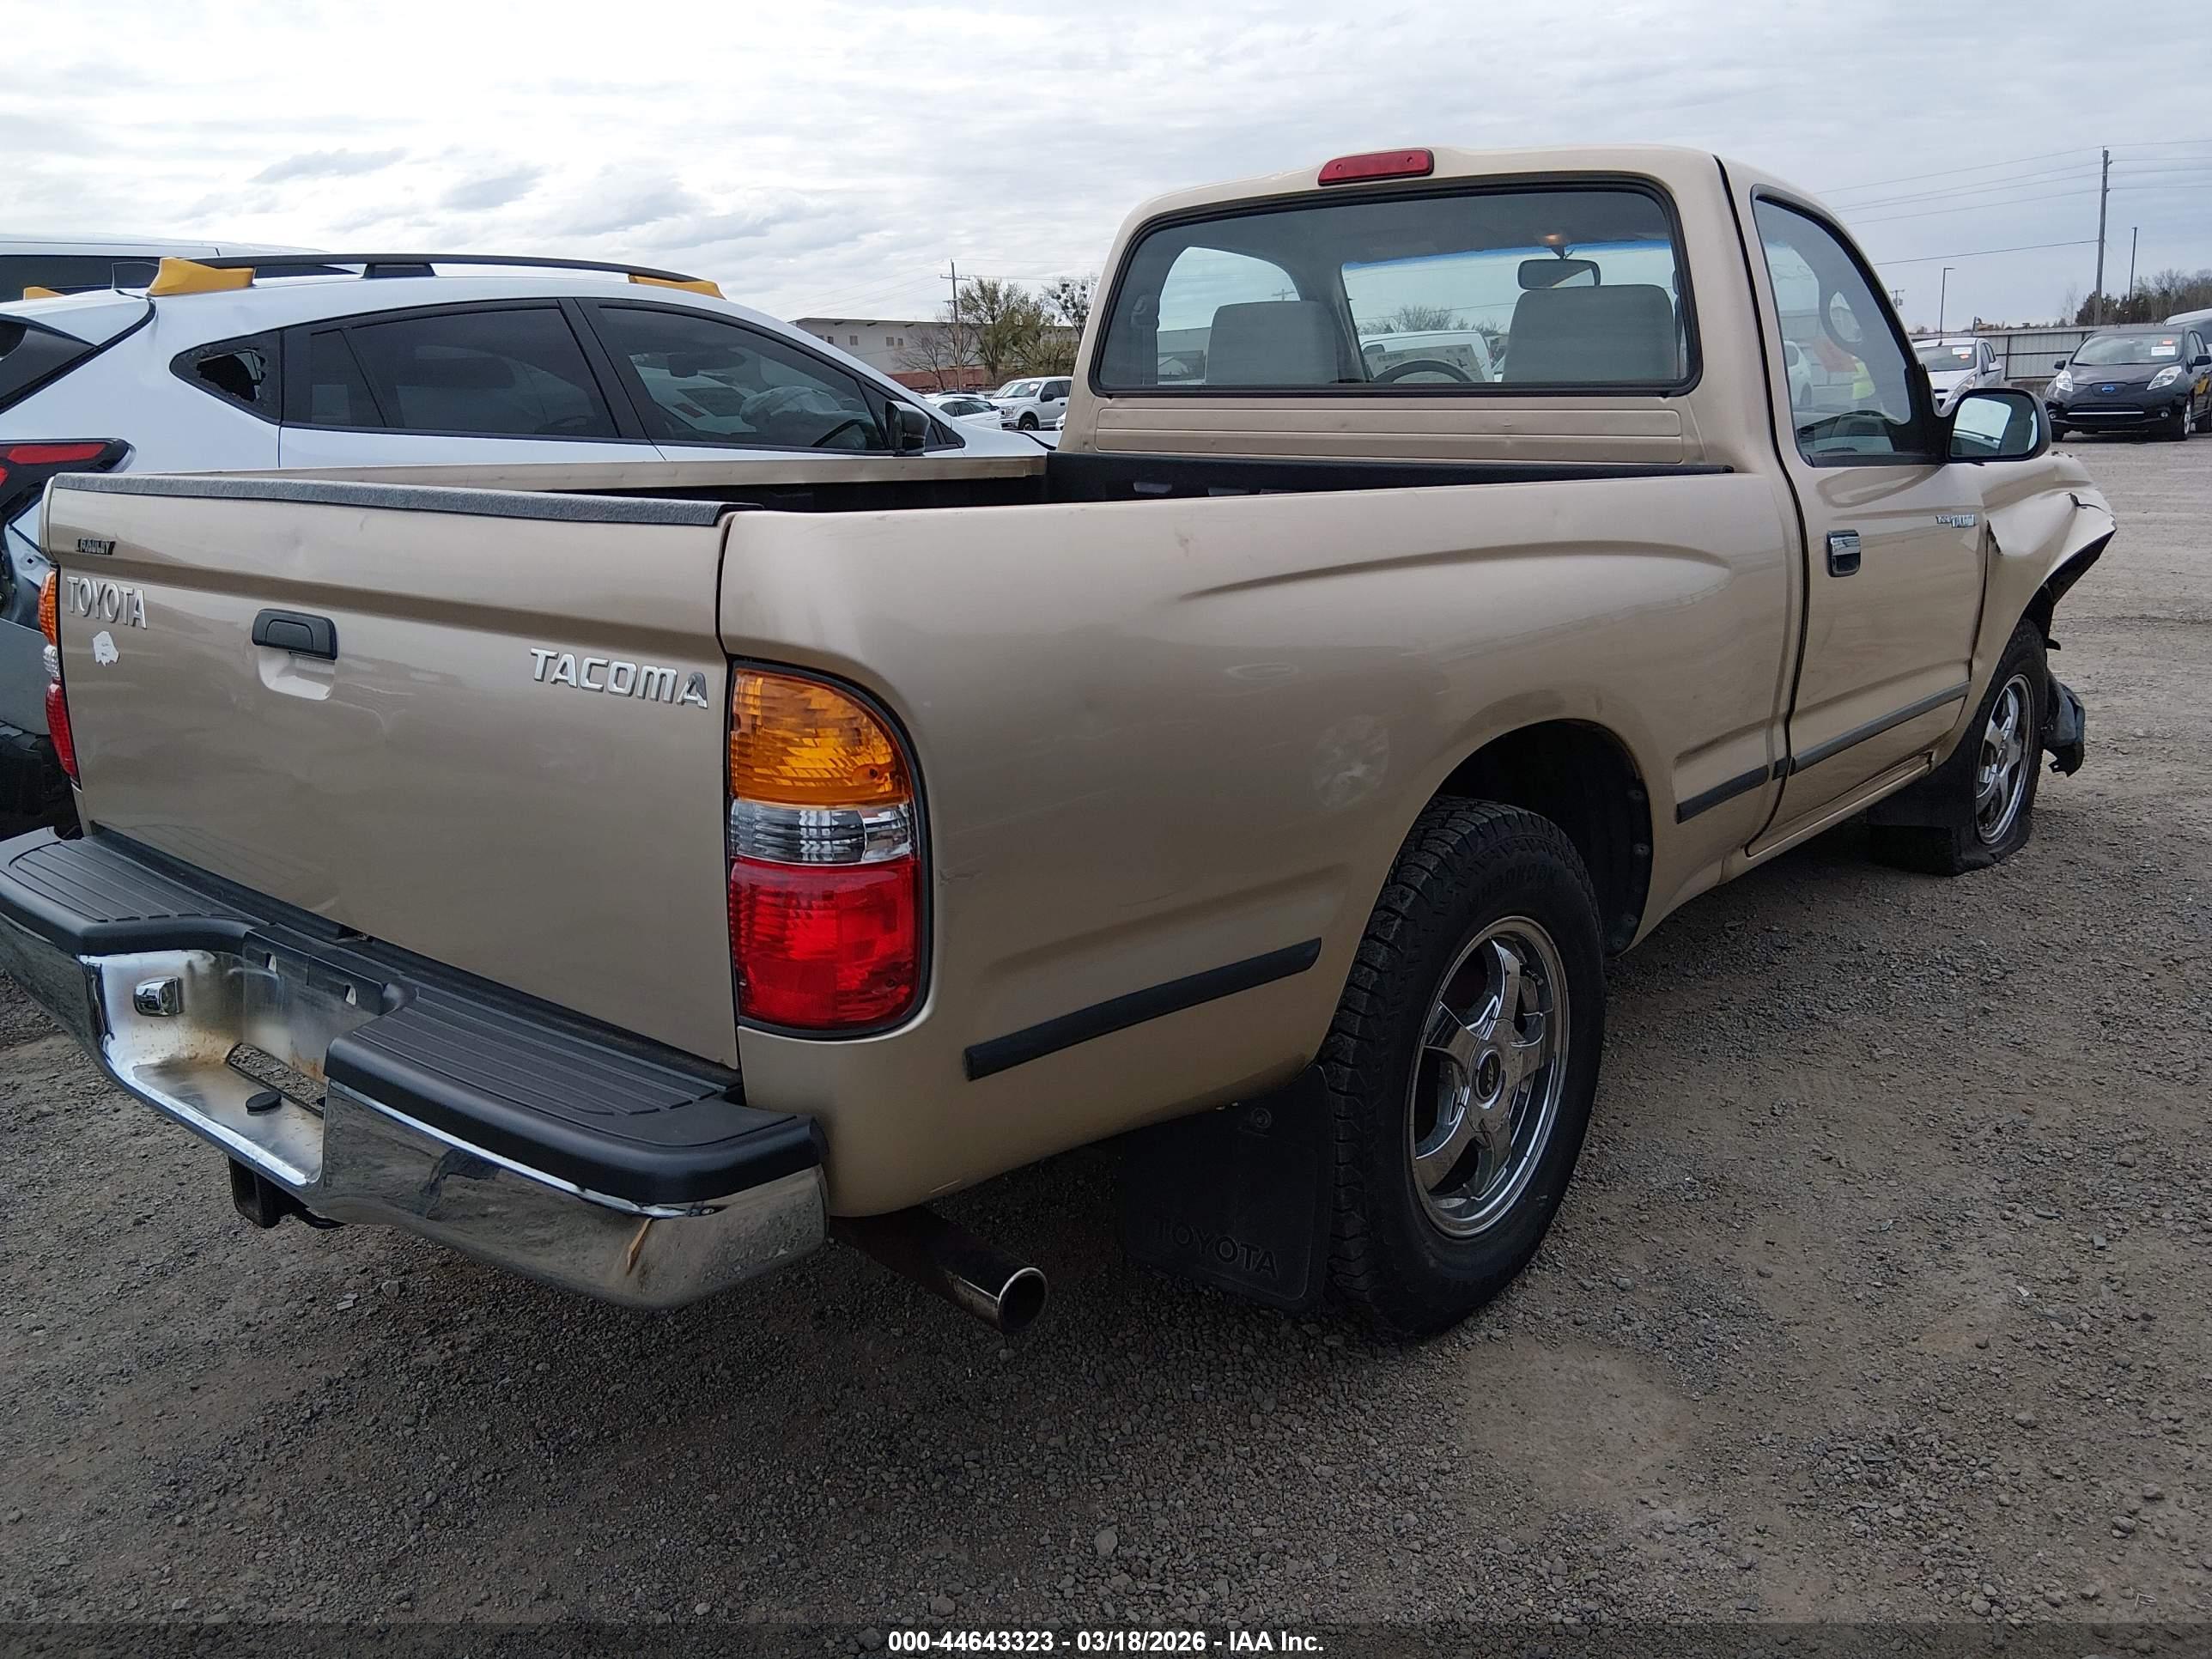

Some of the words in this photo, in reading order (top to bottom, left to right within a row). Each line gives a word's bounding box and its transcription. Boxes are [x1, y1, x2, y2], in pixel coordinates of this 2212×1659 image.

[67, 576, 148, 629] TOYOTA
[530, 647, 708, 709] TACOMA
[1155, 1220, 1278, 1279] TOYOTA
